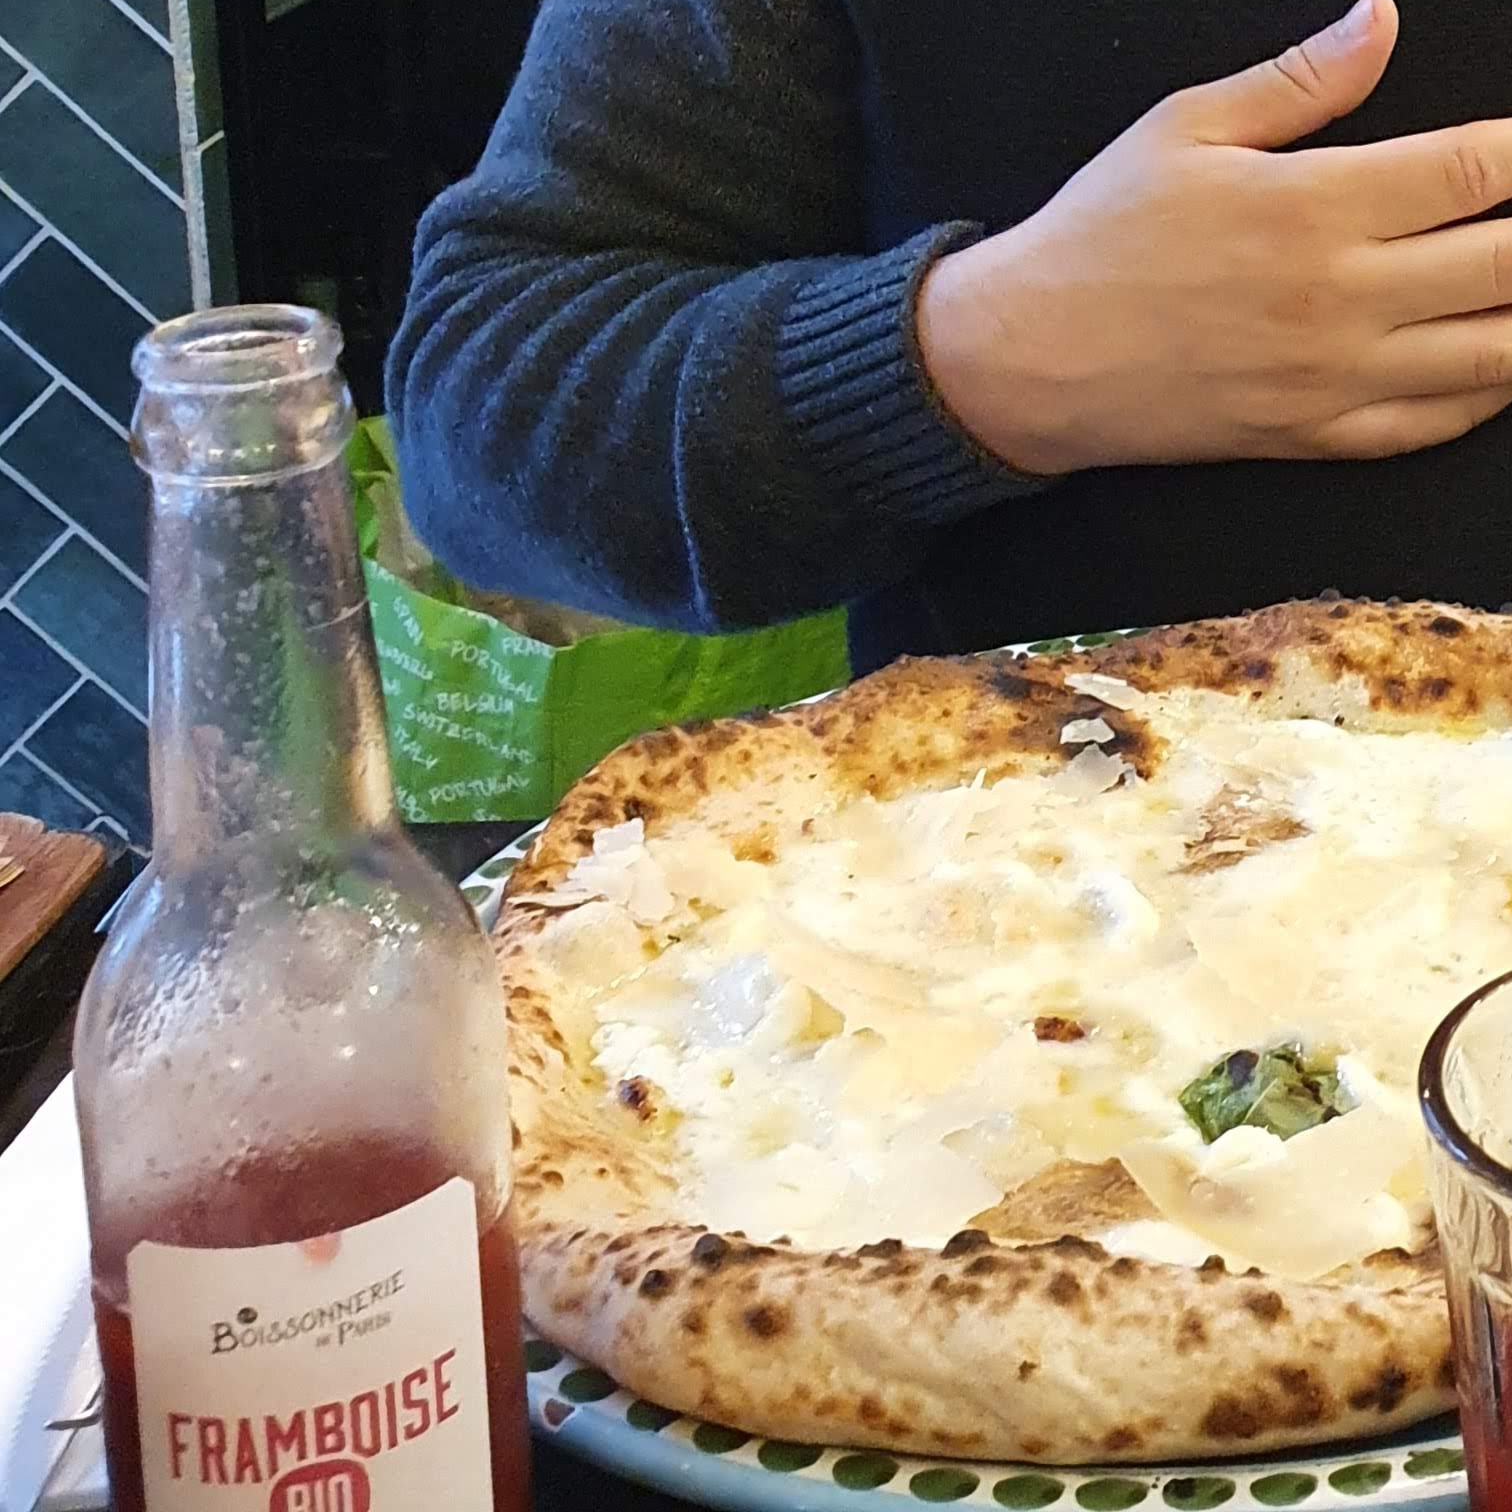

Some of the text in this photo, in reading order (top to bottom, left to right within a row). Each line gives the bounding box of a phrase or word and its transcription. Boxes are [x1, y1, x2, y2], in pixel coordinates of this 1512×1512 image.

[450, 639, 538, 703] PORTUGAL
[402, 702, 537, 765] SWITZERLAND
[428, 775, 530, 805] PORTUGAL
[211, 1269, 406, 1355] BOISSONNERIE
[166, 1347, 462, 1485] FRAMBOISE
